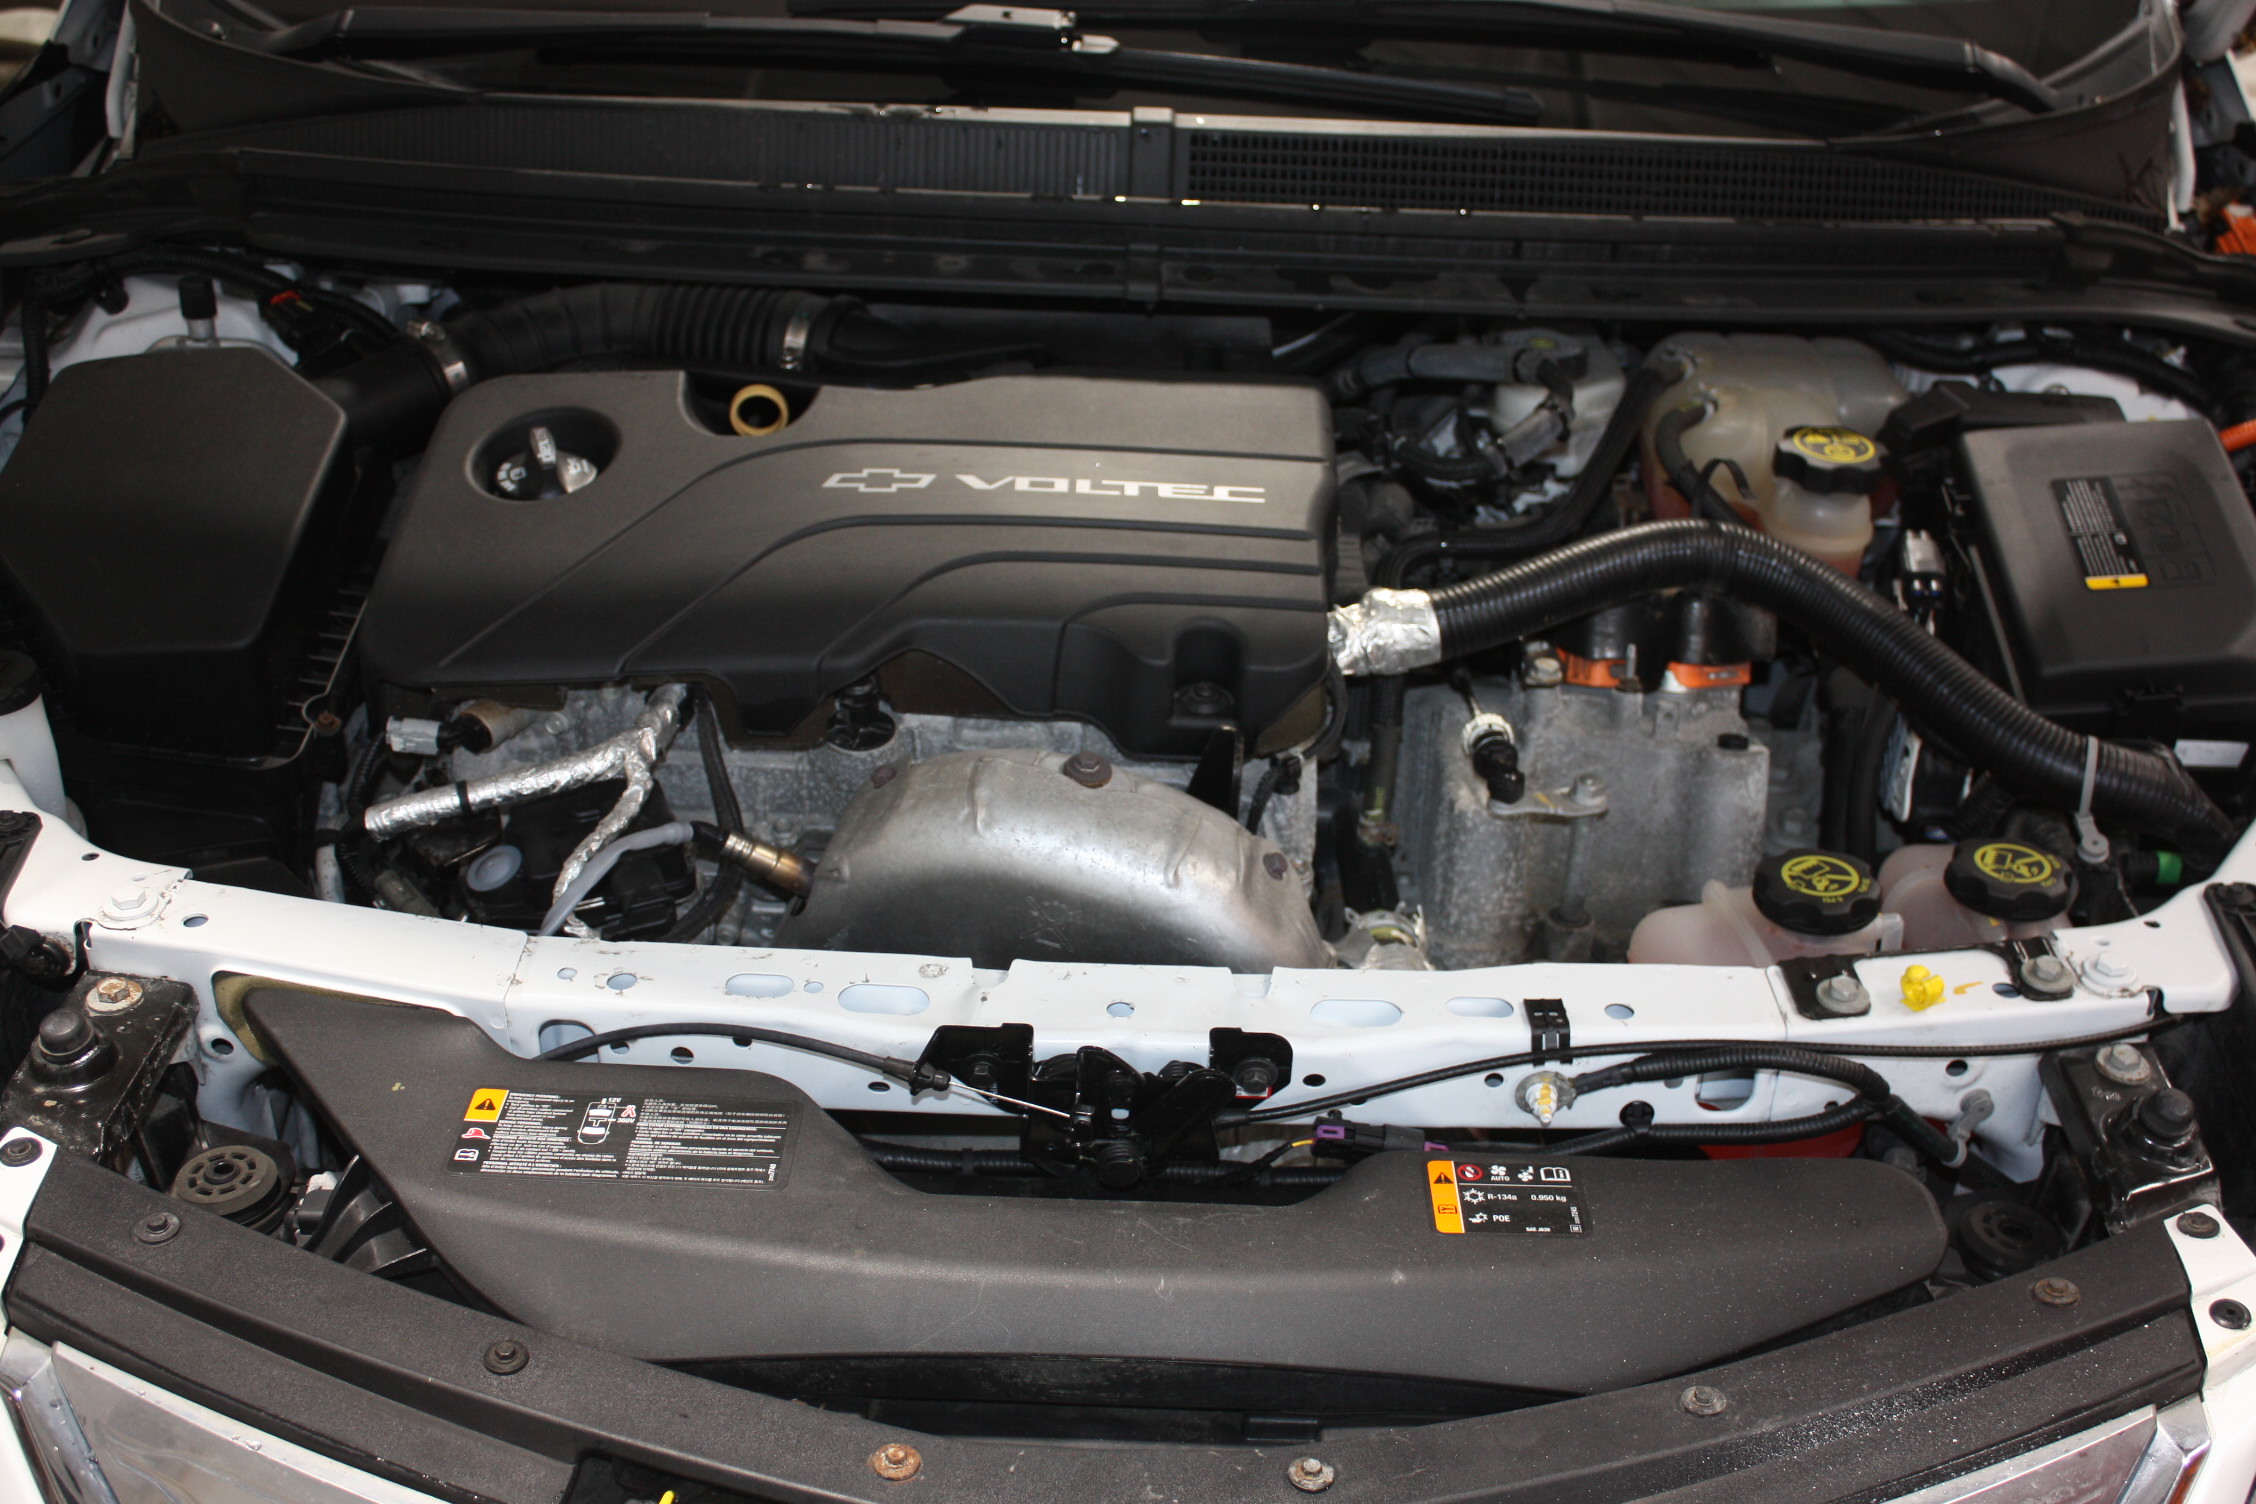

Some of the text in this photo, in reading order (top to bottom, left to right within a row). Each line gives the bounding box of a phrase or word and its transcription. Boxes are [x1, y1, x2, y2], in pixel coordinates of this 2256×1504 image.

[955, 474, 1266, 503] VOLTEC
[1487, 1193, 1567, 1203] R-134a 0.950 kg
[1492, 1214, 1511, 1222] POE
